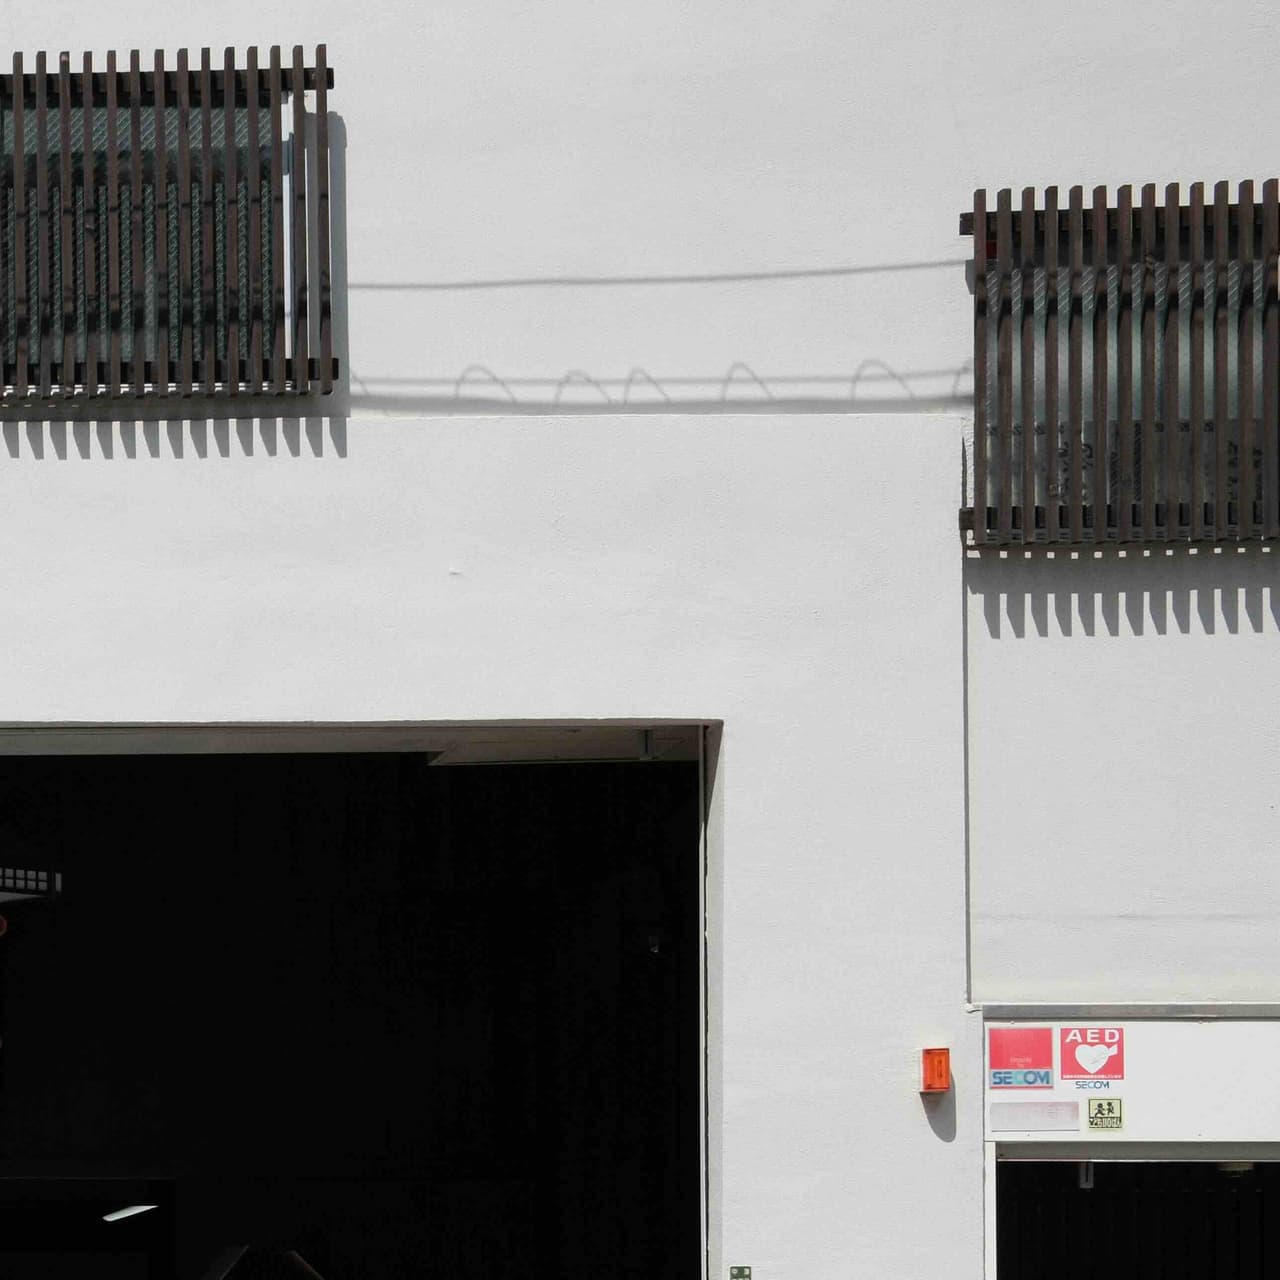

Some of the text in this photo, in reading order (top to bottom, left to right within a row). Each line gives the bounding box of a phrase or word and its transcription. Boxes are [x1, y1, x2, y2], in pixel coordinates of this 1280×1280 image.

[1065, 1029, 1120, 1043] AED
[992, 1070, 1050, 1085] SECOM
[1075, 1080, 1110, 1089] SECOM
